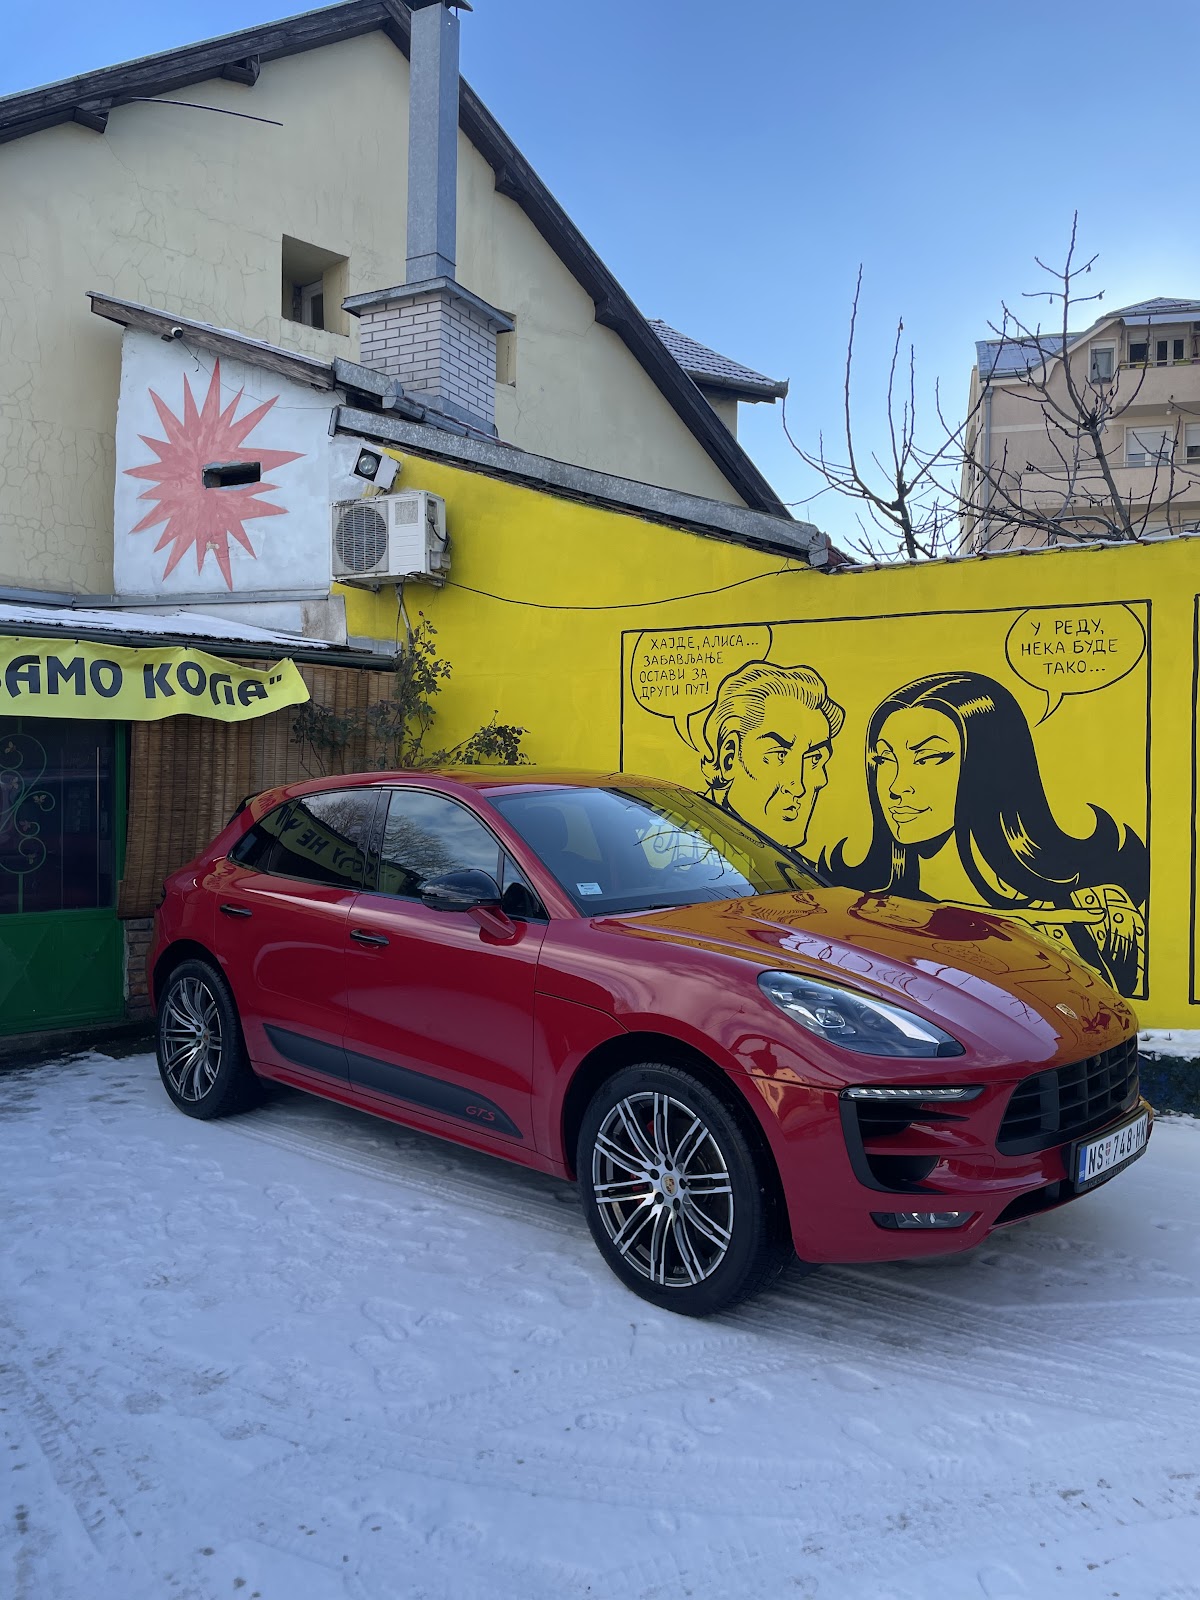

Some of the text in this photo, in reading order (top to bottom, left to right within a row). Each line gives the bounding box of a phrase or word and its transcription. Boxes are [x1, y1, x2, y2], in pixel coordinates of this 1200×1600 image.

[1030, 618, 1104, 637] У РЕДУ,
[1021, 639, 1118, 656] НЕКА БУДЕ
[643, 651, 724, 667] ЗАБАВЉАЊЕ
[1043, 660, 1106, 675] ТАКО...
[0, 655, 123, 699] АМО
[639, 668, 708, 683] ОСТАВИ ЗА
[640, 681, 709, 700] ДРУГИ ПУТ!
[465, 1105, 496, 1121] GTS
[1088, 1143, 1104, 1175] NS
